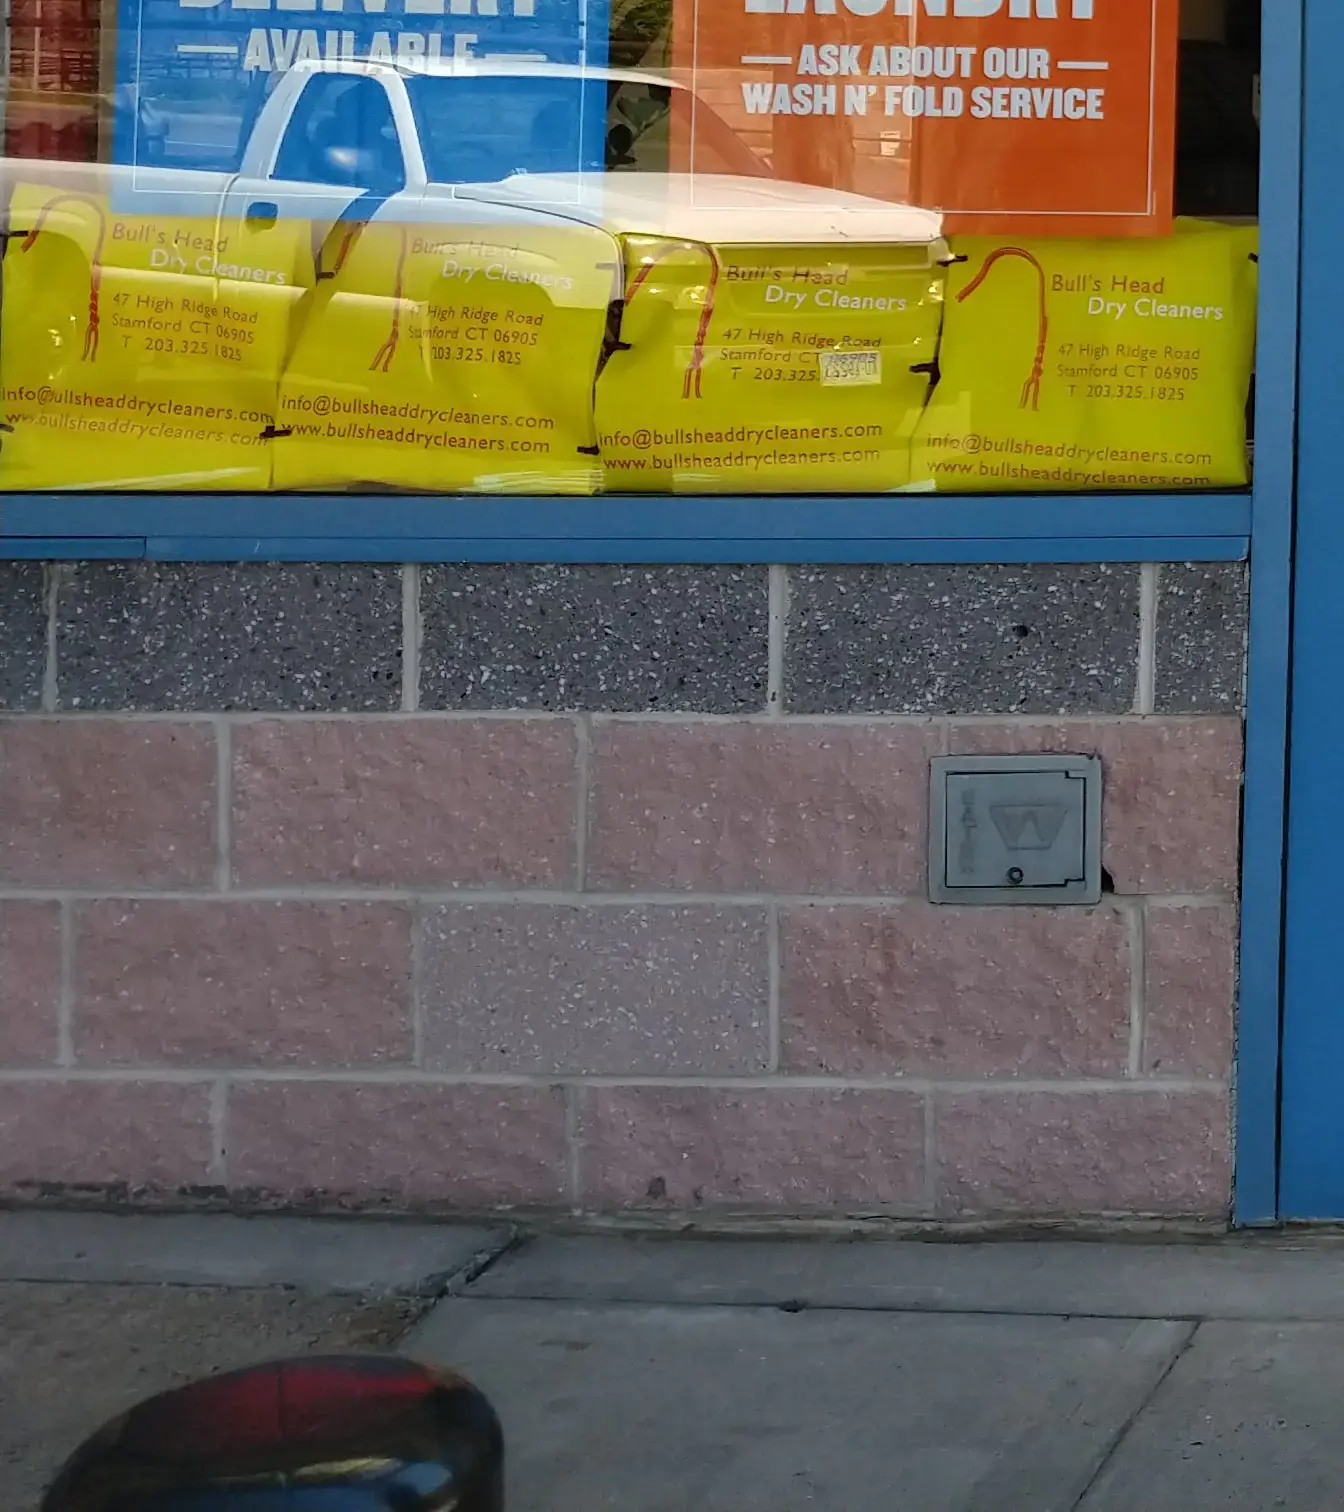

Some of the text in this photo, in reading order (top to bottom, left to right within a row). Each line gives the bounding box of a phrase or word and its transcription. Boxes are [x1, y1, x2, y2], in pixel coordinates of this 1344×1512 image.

[242, 27, 480, 75] AVAILABLE
[796, 43, 1050, 80] ASK ABOUT OUR
[741, 82, 838, 117] WASH
[885, 85, 963, 120] FOLD
[970, 87, 1105, 121] SERVICE
[112, 221, 229, 254] Bull's Head
[150, 247, 288, 286] Dry Cleaners
[441, 259, 575, 290] Dry Cleaners
[791, 267, 849, 286] Head
[764, 283, 908, 312] Dry Cleaners
[1051, 273, 1166, 295] Bull's Head
[113, 292, 259, 325] 47 High Ridge Road
[426, 304, 456, 322] High
[460, 306, 499, 324] Ridge
[504, 309, 545, 327] Road
[1087, 296, 1224, 321] Dry Cleaners
[112, 312, 256, 345] Stamford CT 06905
[121, 335, 132, 349] T
[465, 326, 490, 341] CT
[493, 328, 539, 347] 06905
[722, 327, 883, 350] 47 High Ridge Road
[719, 347, 792, 364] Stamford
[797, 351, 821, 365] CT
[1058, 343, 1201, 362] 47 High Ridge Road
[730, 366, 743, 380] T
[1056, 364, 1199, 381] Stamford CT 06905
[1067, 384, 1185, 401] T 203.325.1825
[281, 393, 555, 431] info@bullsheaddrycleaners.com
[279, 421, 551, 455] www.bullsheaddrycleaners.com
[599, 423, 884, 451] info@bullsheaddrycleaners.com
[926, 432, 1213, 467] info@bullsheaddrycleaners.com
[602, 446, 881, 477] www.bullsheaddrycleaners.com
[926, 457, 1211, 487] www.bullsheaddrycleaners.com
